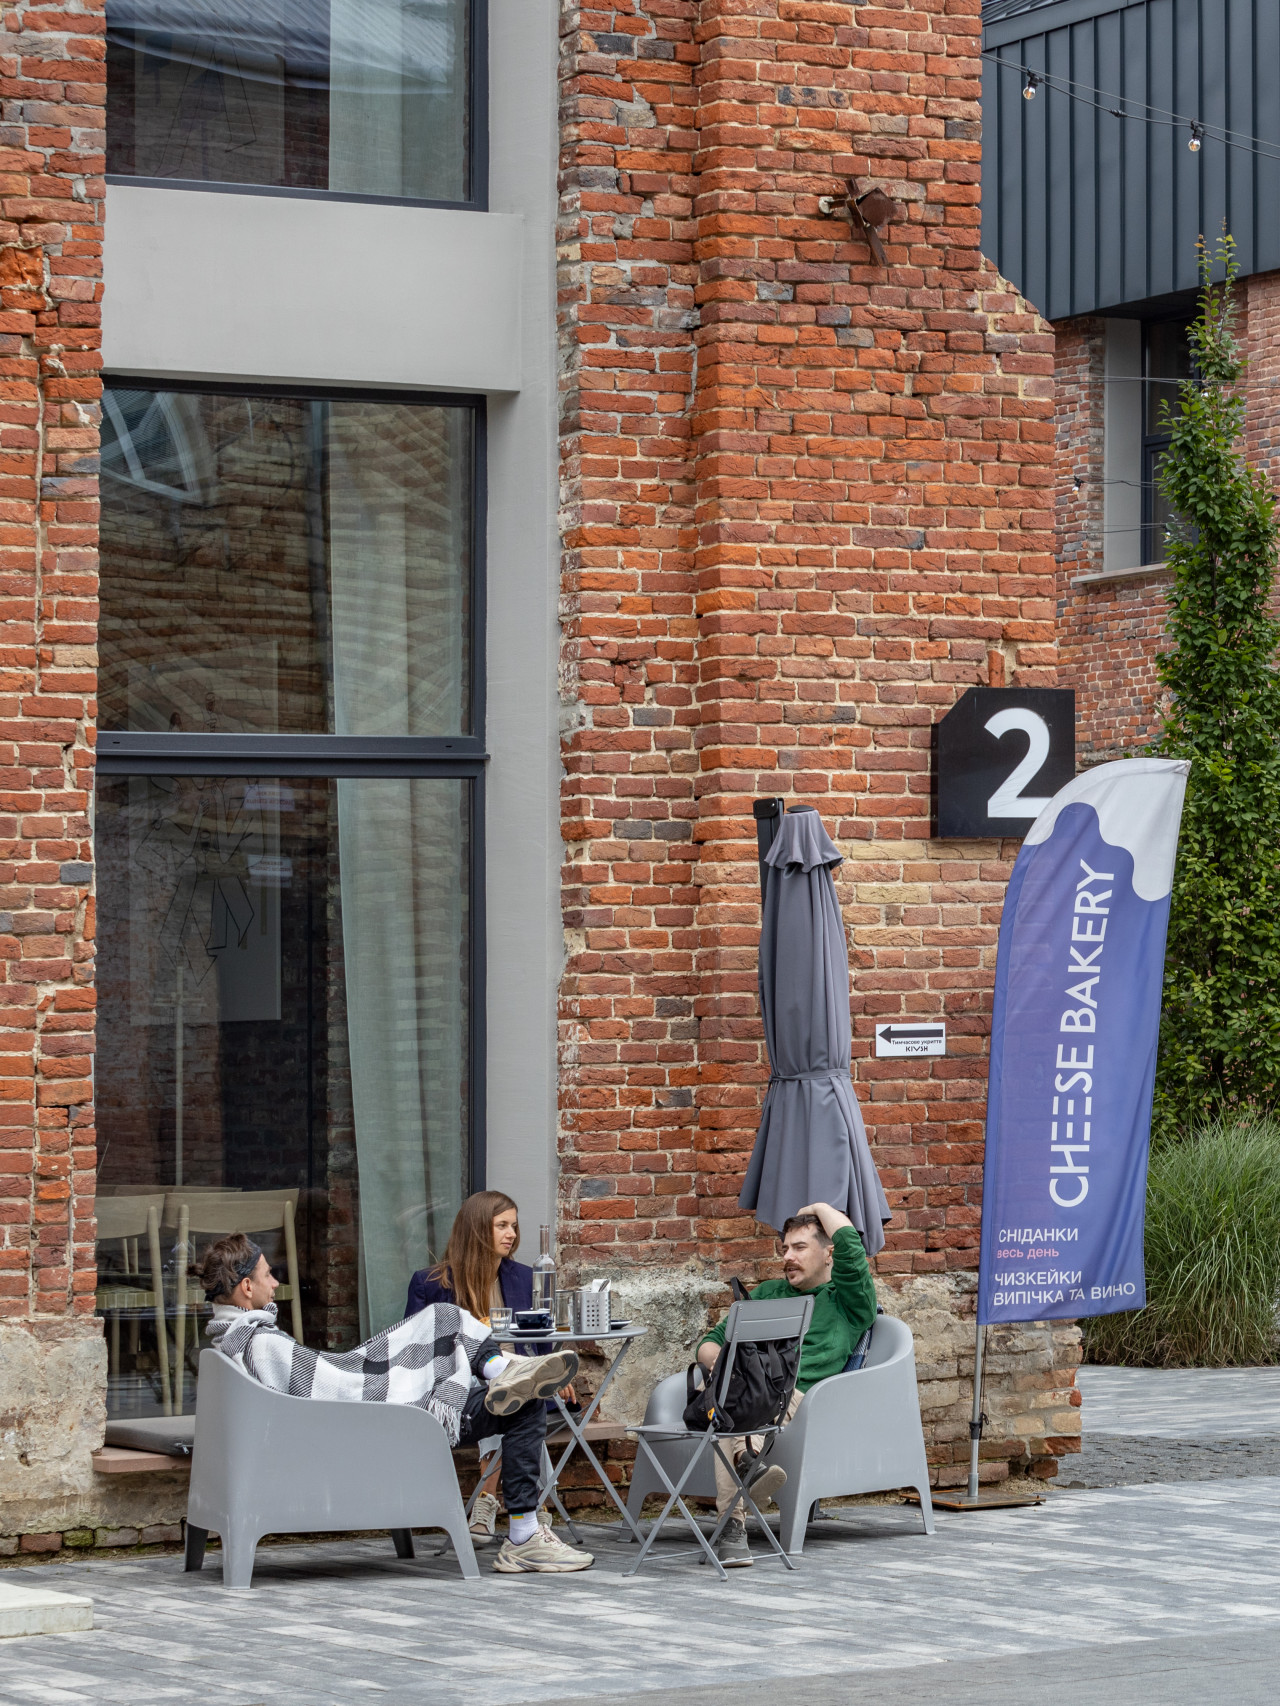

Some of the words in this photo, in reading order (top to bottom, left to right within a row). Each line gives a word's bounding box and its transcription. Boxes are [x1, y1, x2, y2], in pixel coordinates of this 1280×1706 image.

[983, 707, 1054, 818] 2
[1060, 858, 1115, 1033] BAKERY
[1049, 1043, 1095, 1208] CHEESE
[998, 1228, 1078, 1244] СНІДАНКИ
[1027, 1248, 1060, 1260] день
[994, 1269, 1082, 1286] ЧИЗКЕЙКИ
[993, 1290, 1064, 1306] ВИПІЧКА
[1069, 1289, 1085, 1300] ТА
[1090, 1283, 1136, 1300] ВИНО
